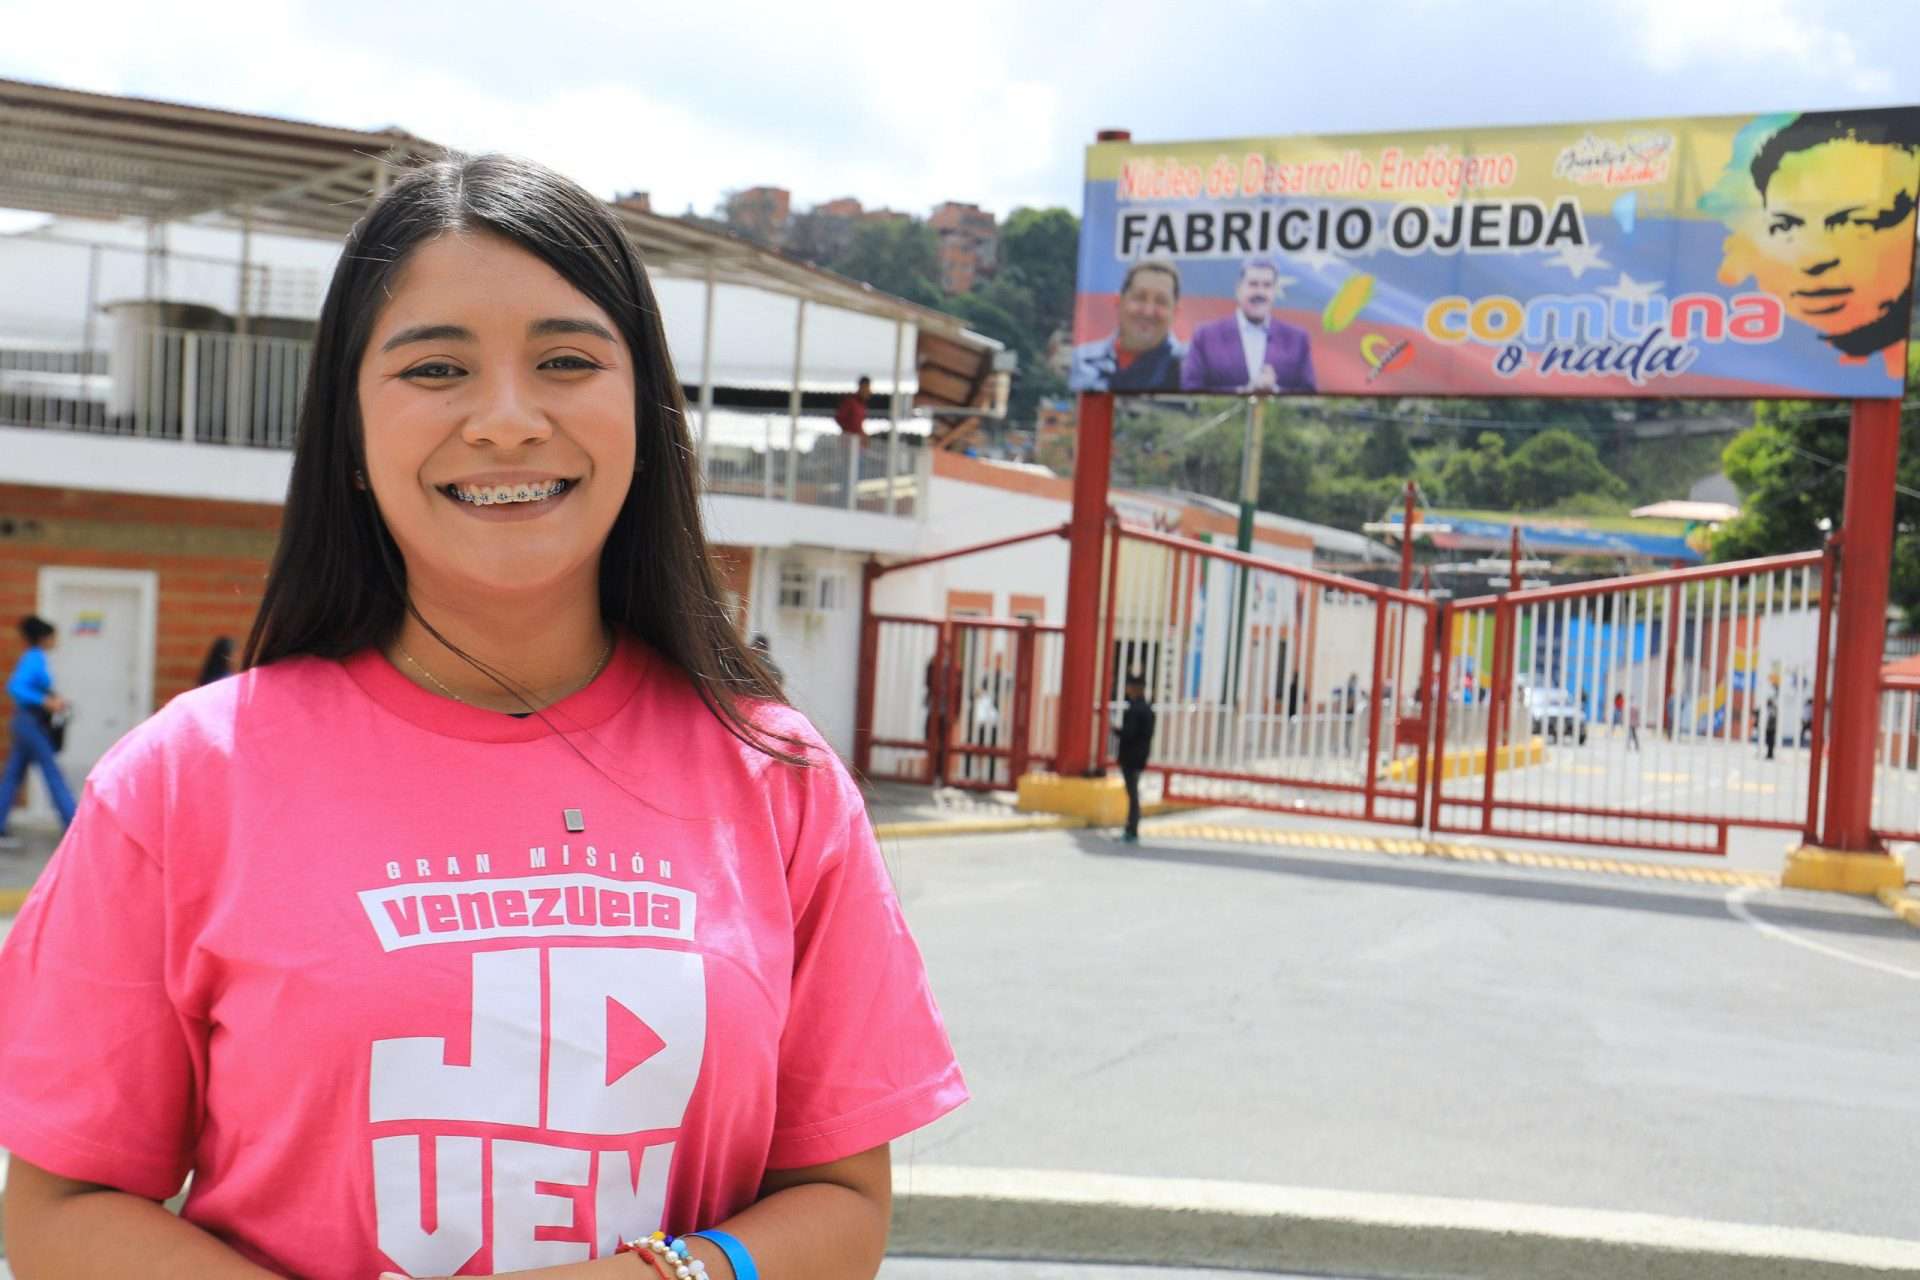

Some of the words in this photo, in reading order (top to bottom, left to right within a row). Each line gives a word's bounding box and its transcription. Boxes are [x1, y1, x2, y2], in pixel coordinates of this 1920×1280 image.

[1118, 158, 1201, 198] Núcleo
[1207, 156, 1238, 196] de
[1242, 150, 1372, 194] Desarrollo
[1380, 146, 1515, 198] Endógeno
[1121, 207, 1373, 255] FABRICIO
[1392, 202, 1584, 250] OJEDA
[1426, 296, 1781, 341] comuna
[1496, 342, 1523, 373] o
[1540, 327, 1690, 381] nada
[386, 853, 491, 880] GRAN
[530, 845, 673, 879] MISIÓN
